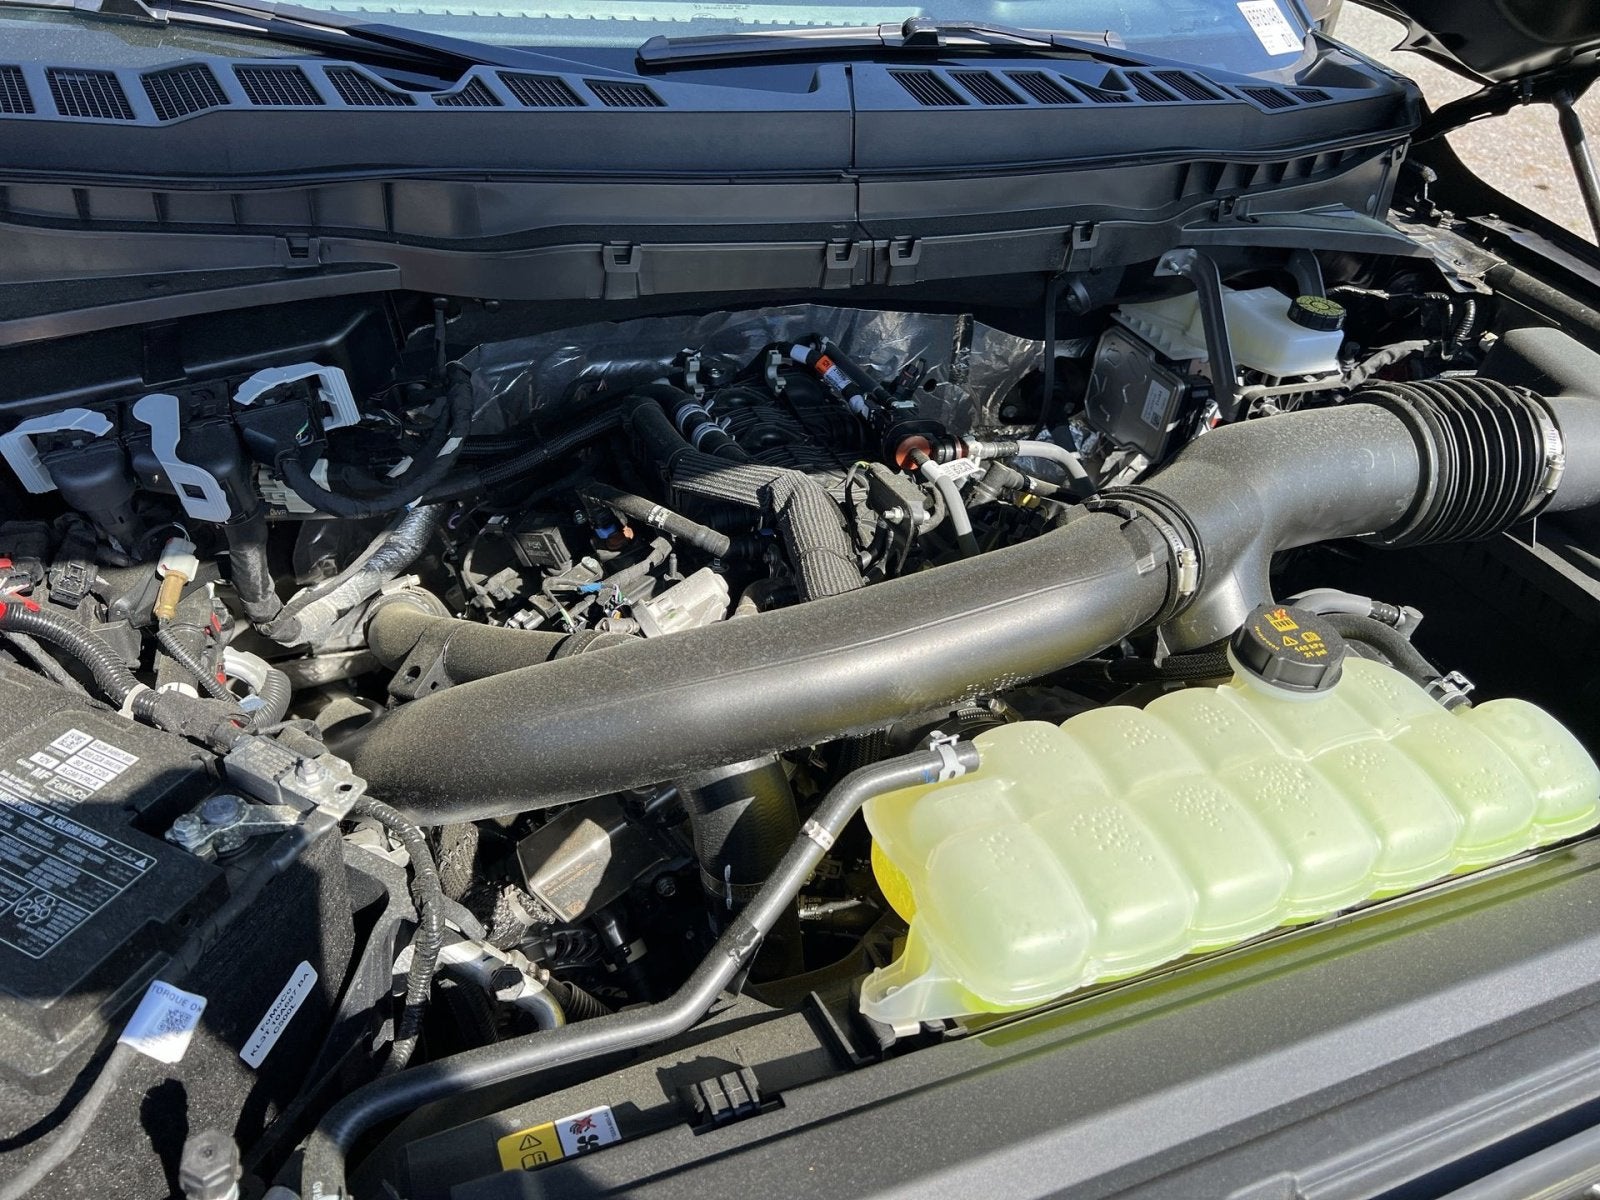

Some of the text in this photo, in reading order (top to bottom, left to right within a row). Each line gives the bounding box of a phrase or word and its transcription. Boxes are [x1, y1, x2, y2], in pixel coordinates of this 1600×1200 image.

[48, 778, 88, 800] FoMoCo
[151, 985, 189, 1007] TORQUE
[259, 987, 292, 1032] FoMoCo
